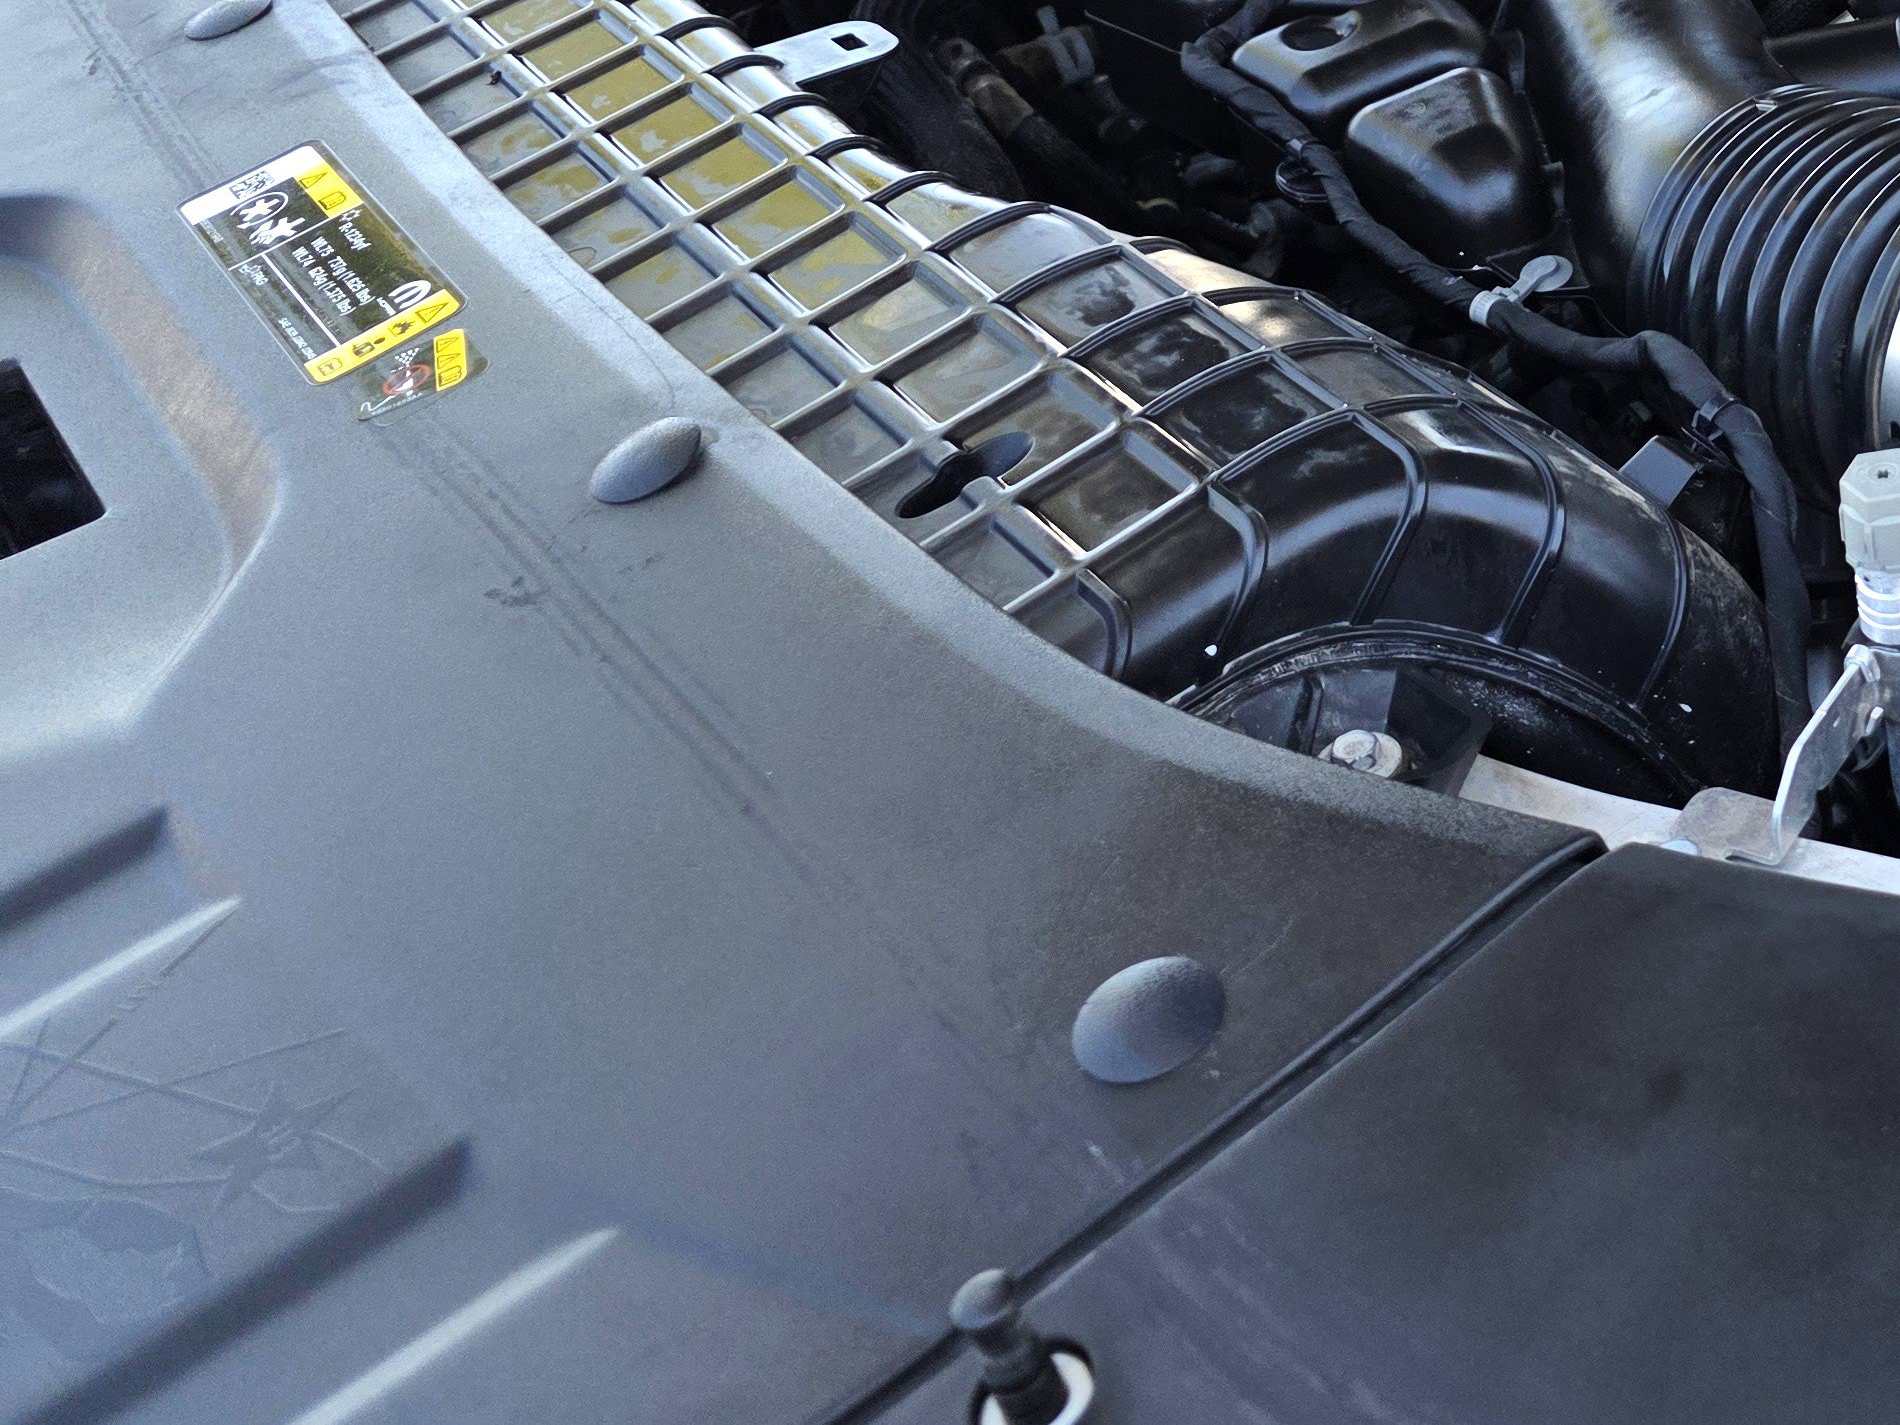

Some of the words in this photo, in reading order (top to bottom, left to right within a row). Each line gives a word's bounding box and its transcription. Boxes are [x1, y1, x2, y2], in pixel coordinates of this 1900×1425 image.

[291, 246, 316, 268] WL74
[308, 266, 329, 287] 624g
[335, 298, 357, 317] lbs)
[310, 236, 335, 257] WL75
[327, 255, 347, 277] 737g
[355, 287, 377, 306] lbs)
